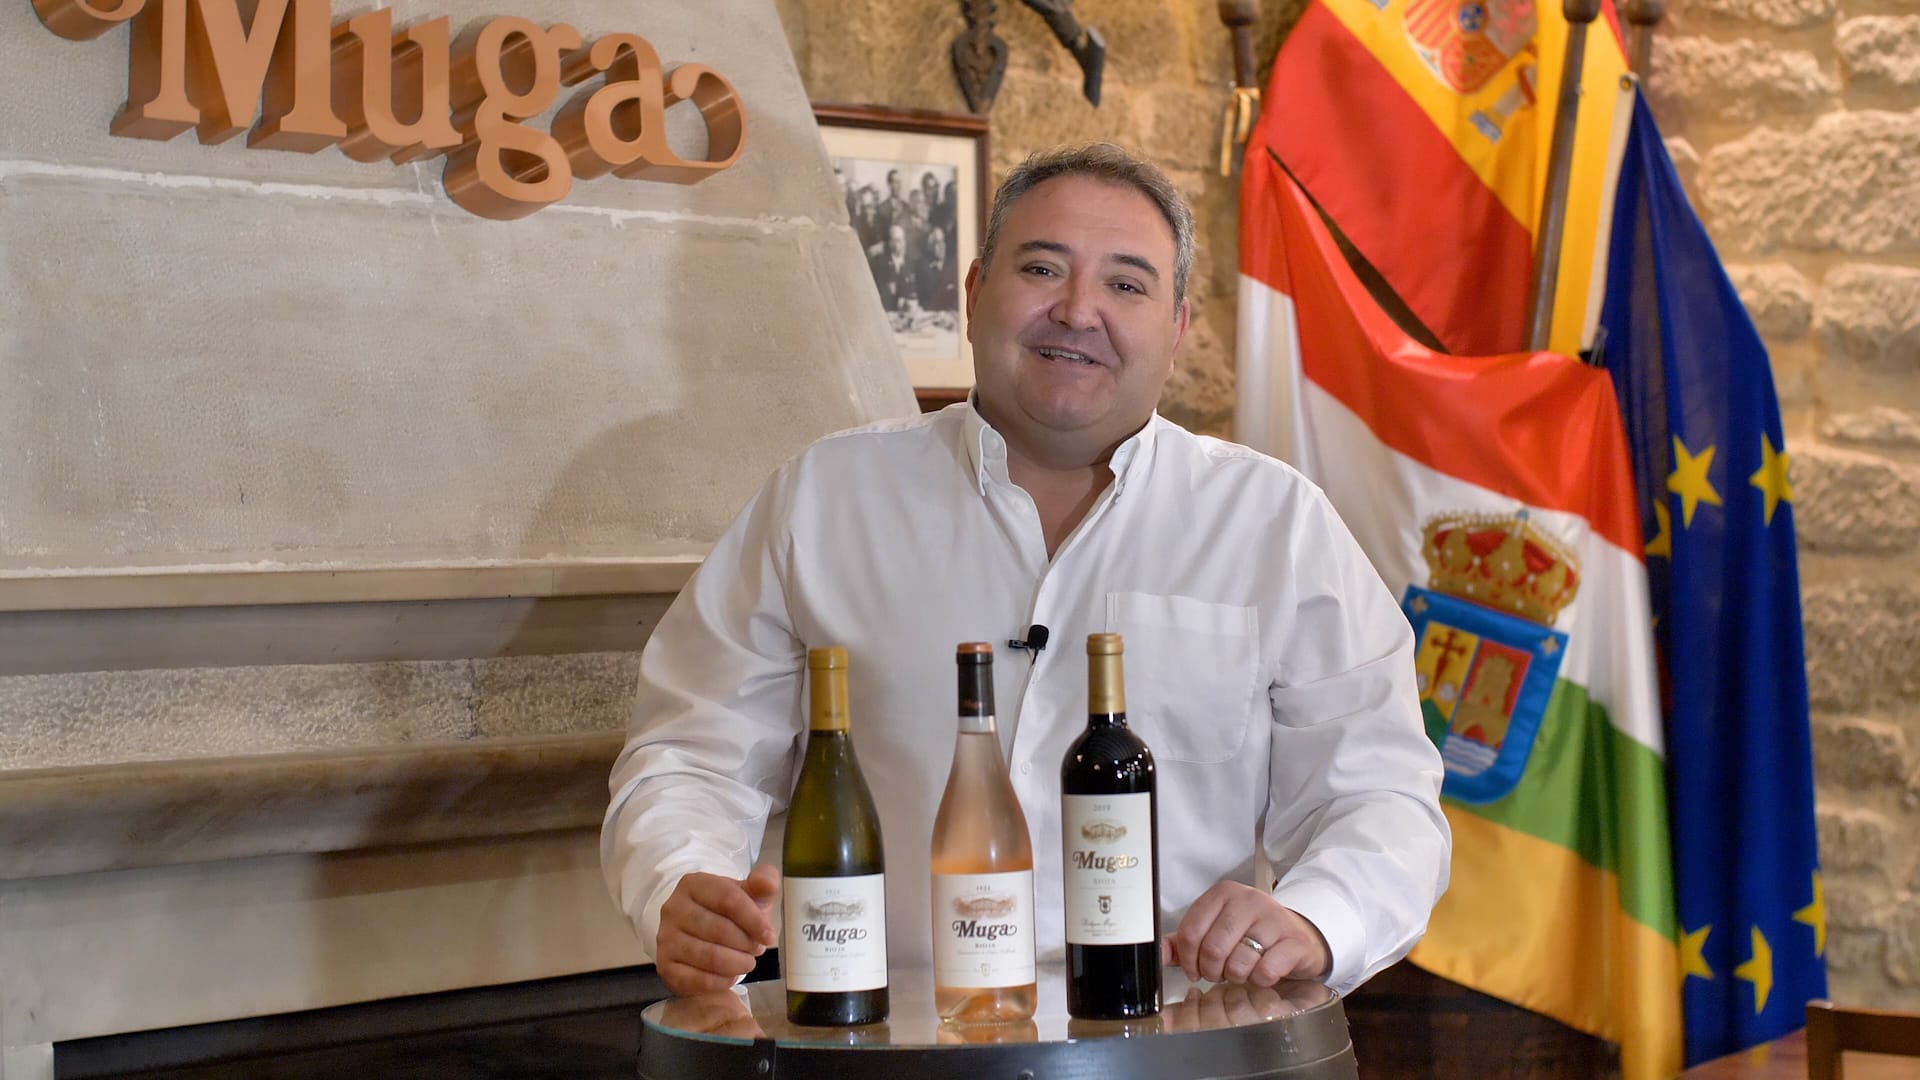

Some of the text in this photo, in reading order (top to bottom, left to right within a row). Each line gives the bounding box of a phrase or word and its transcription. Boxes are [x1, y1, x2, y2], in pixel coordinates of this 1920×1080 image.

[31, 0, 747, 221] Muga
[1072, 850, 1139, 874] Muga
[801, 923, 868, 945] Muga
[952, 920, 1018, 942] Muga
